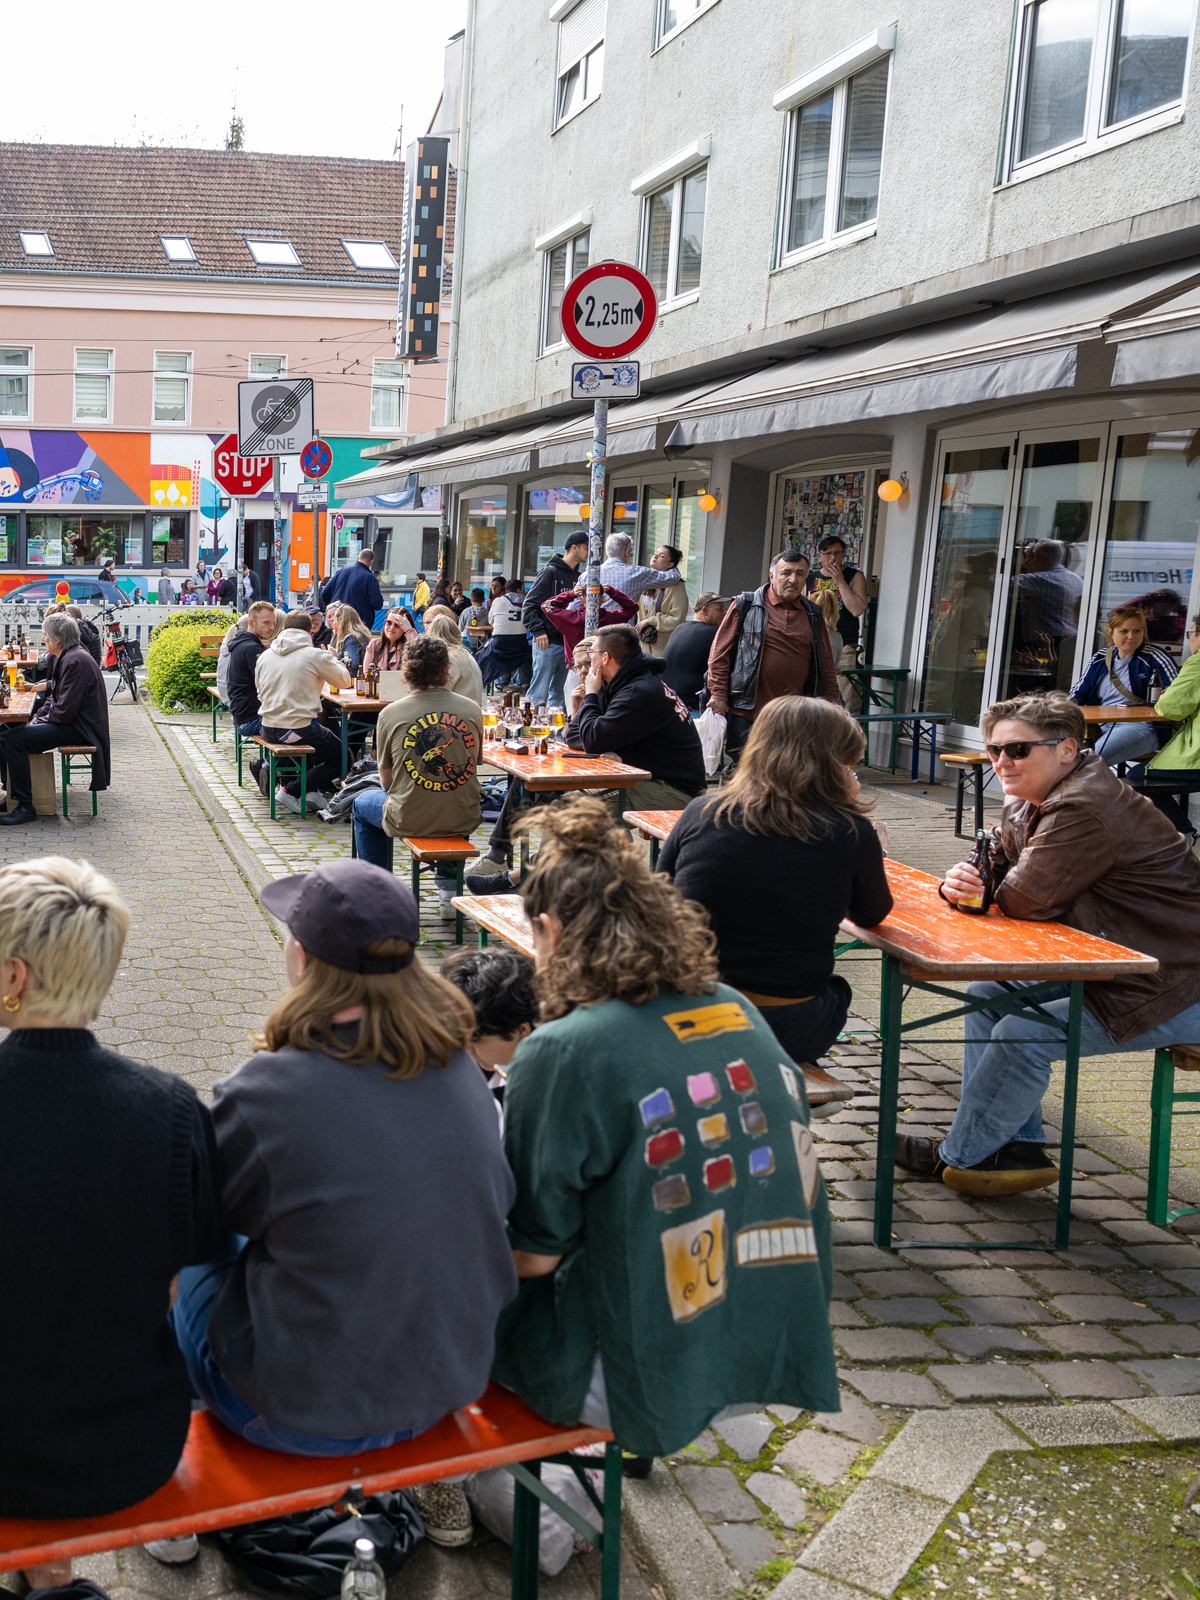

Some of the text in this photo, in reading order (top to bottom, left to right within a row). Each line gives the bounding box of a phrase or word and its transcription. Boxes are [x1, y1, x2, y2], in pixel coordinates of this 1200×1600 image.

[585, 295, 634, 329] 2,25m
[258, 438, 295, 451] ZONE
[218, 452, 269, 477] STOP
[402, 712, 475, 750] TRIUMPH
